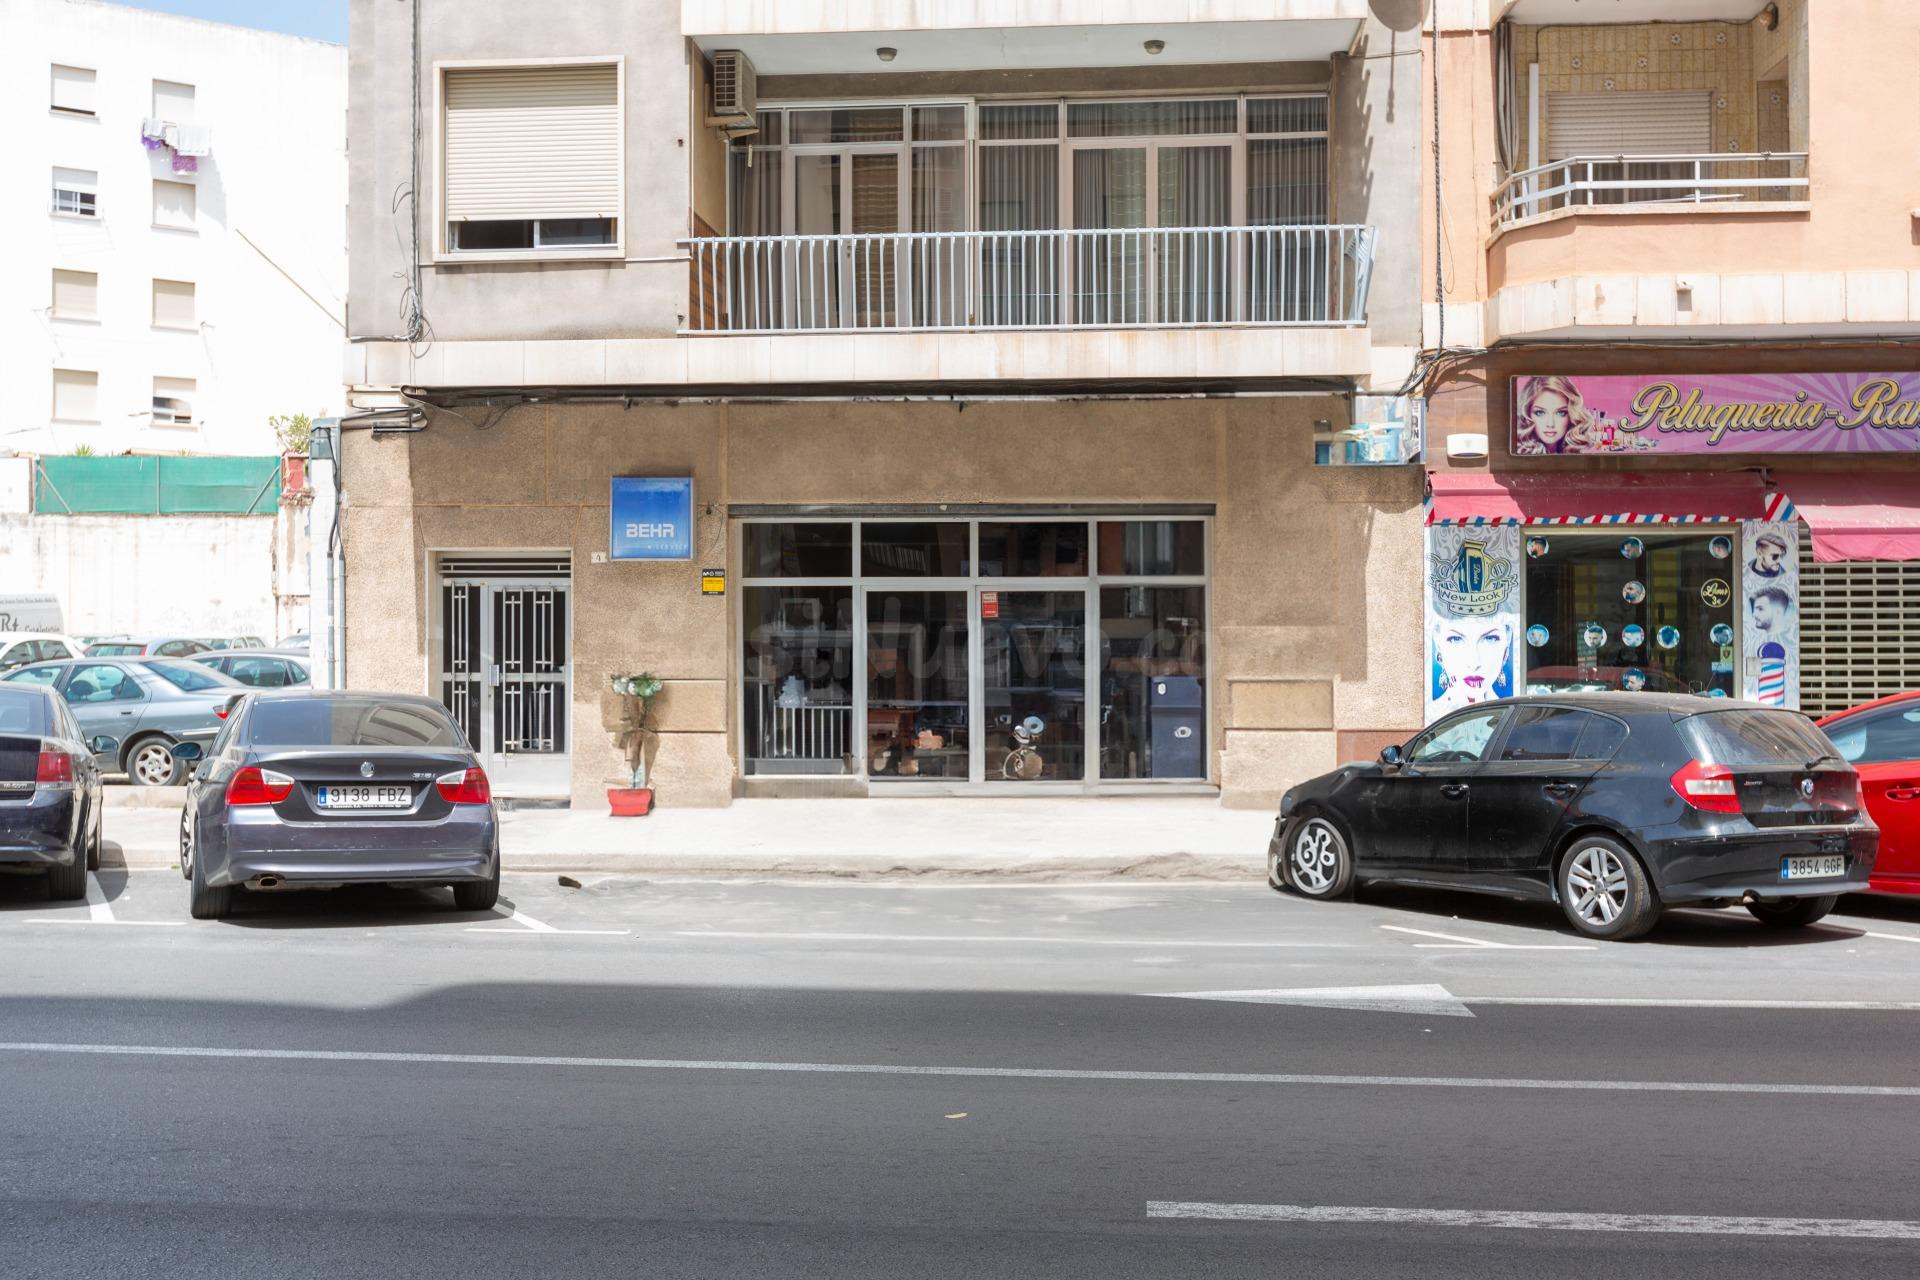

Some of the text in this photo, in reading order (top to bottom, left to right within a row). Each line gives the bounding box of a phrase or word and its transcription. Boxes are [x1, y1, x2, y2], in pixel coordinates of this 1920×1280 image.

[625, 523, 675, 538] BEHR
[1441, 590, 1500, 603] New Look
[331, 787, 406, 802] 9138 FBZ
[1791, 858, 1842, 875] 3854 GGF
